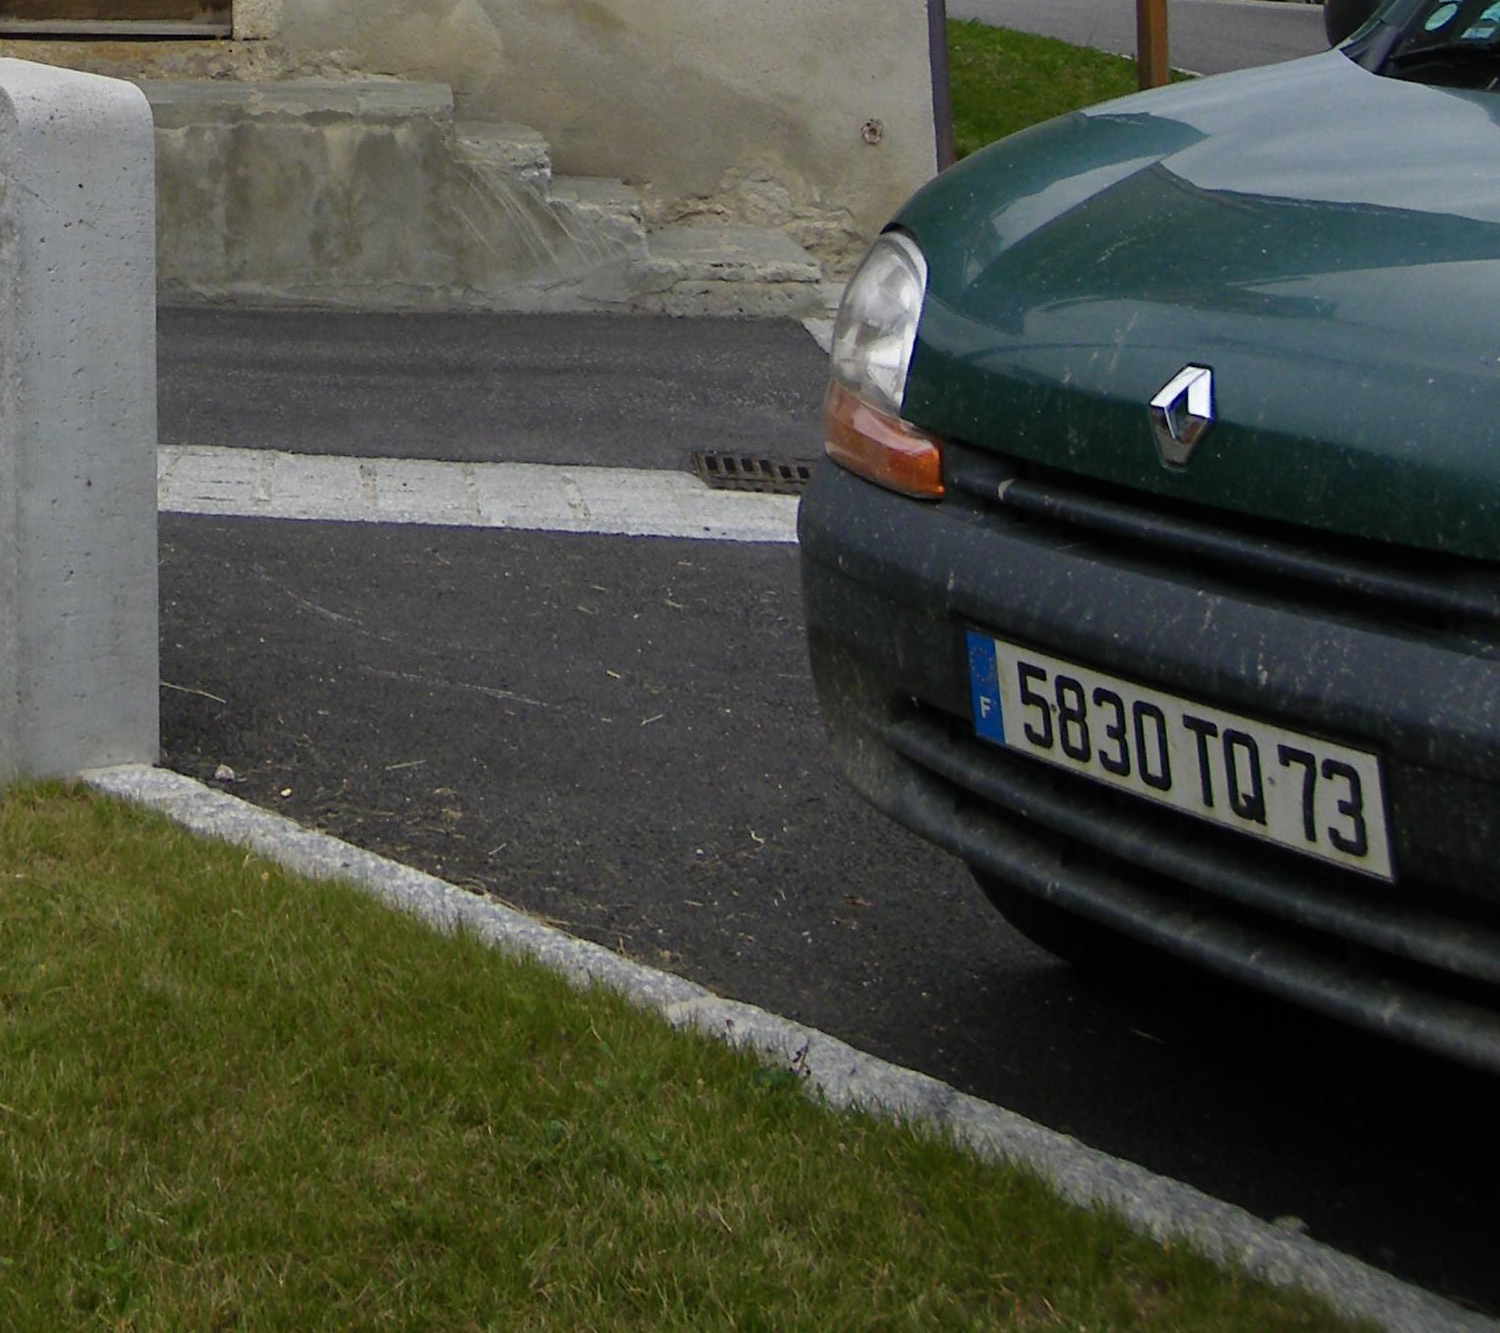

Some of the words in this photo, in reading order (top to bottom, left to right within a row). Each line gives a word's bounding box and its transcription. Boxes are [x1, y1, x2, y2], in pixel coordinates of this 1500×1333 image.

[979, 695, 992, 719] F
[1016, 660, 1173, 792] 5830
[1183, 714, 1267, 826] TQ
[1277, 743, 1369, 858] 73
